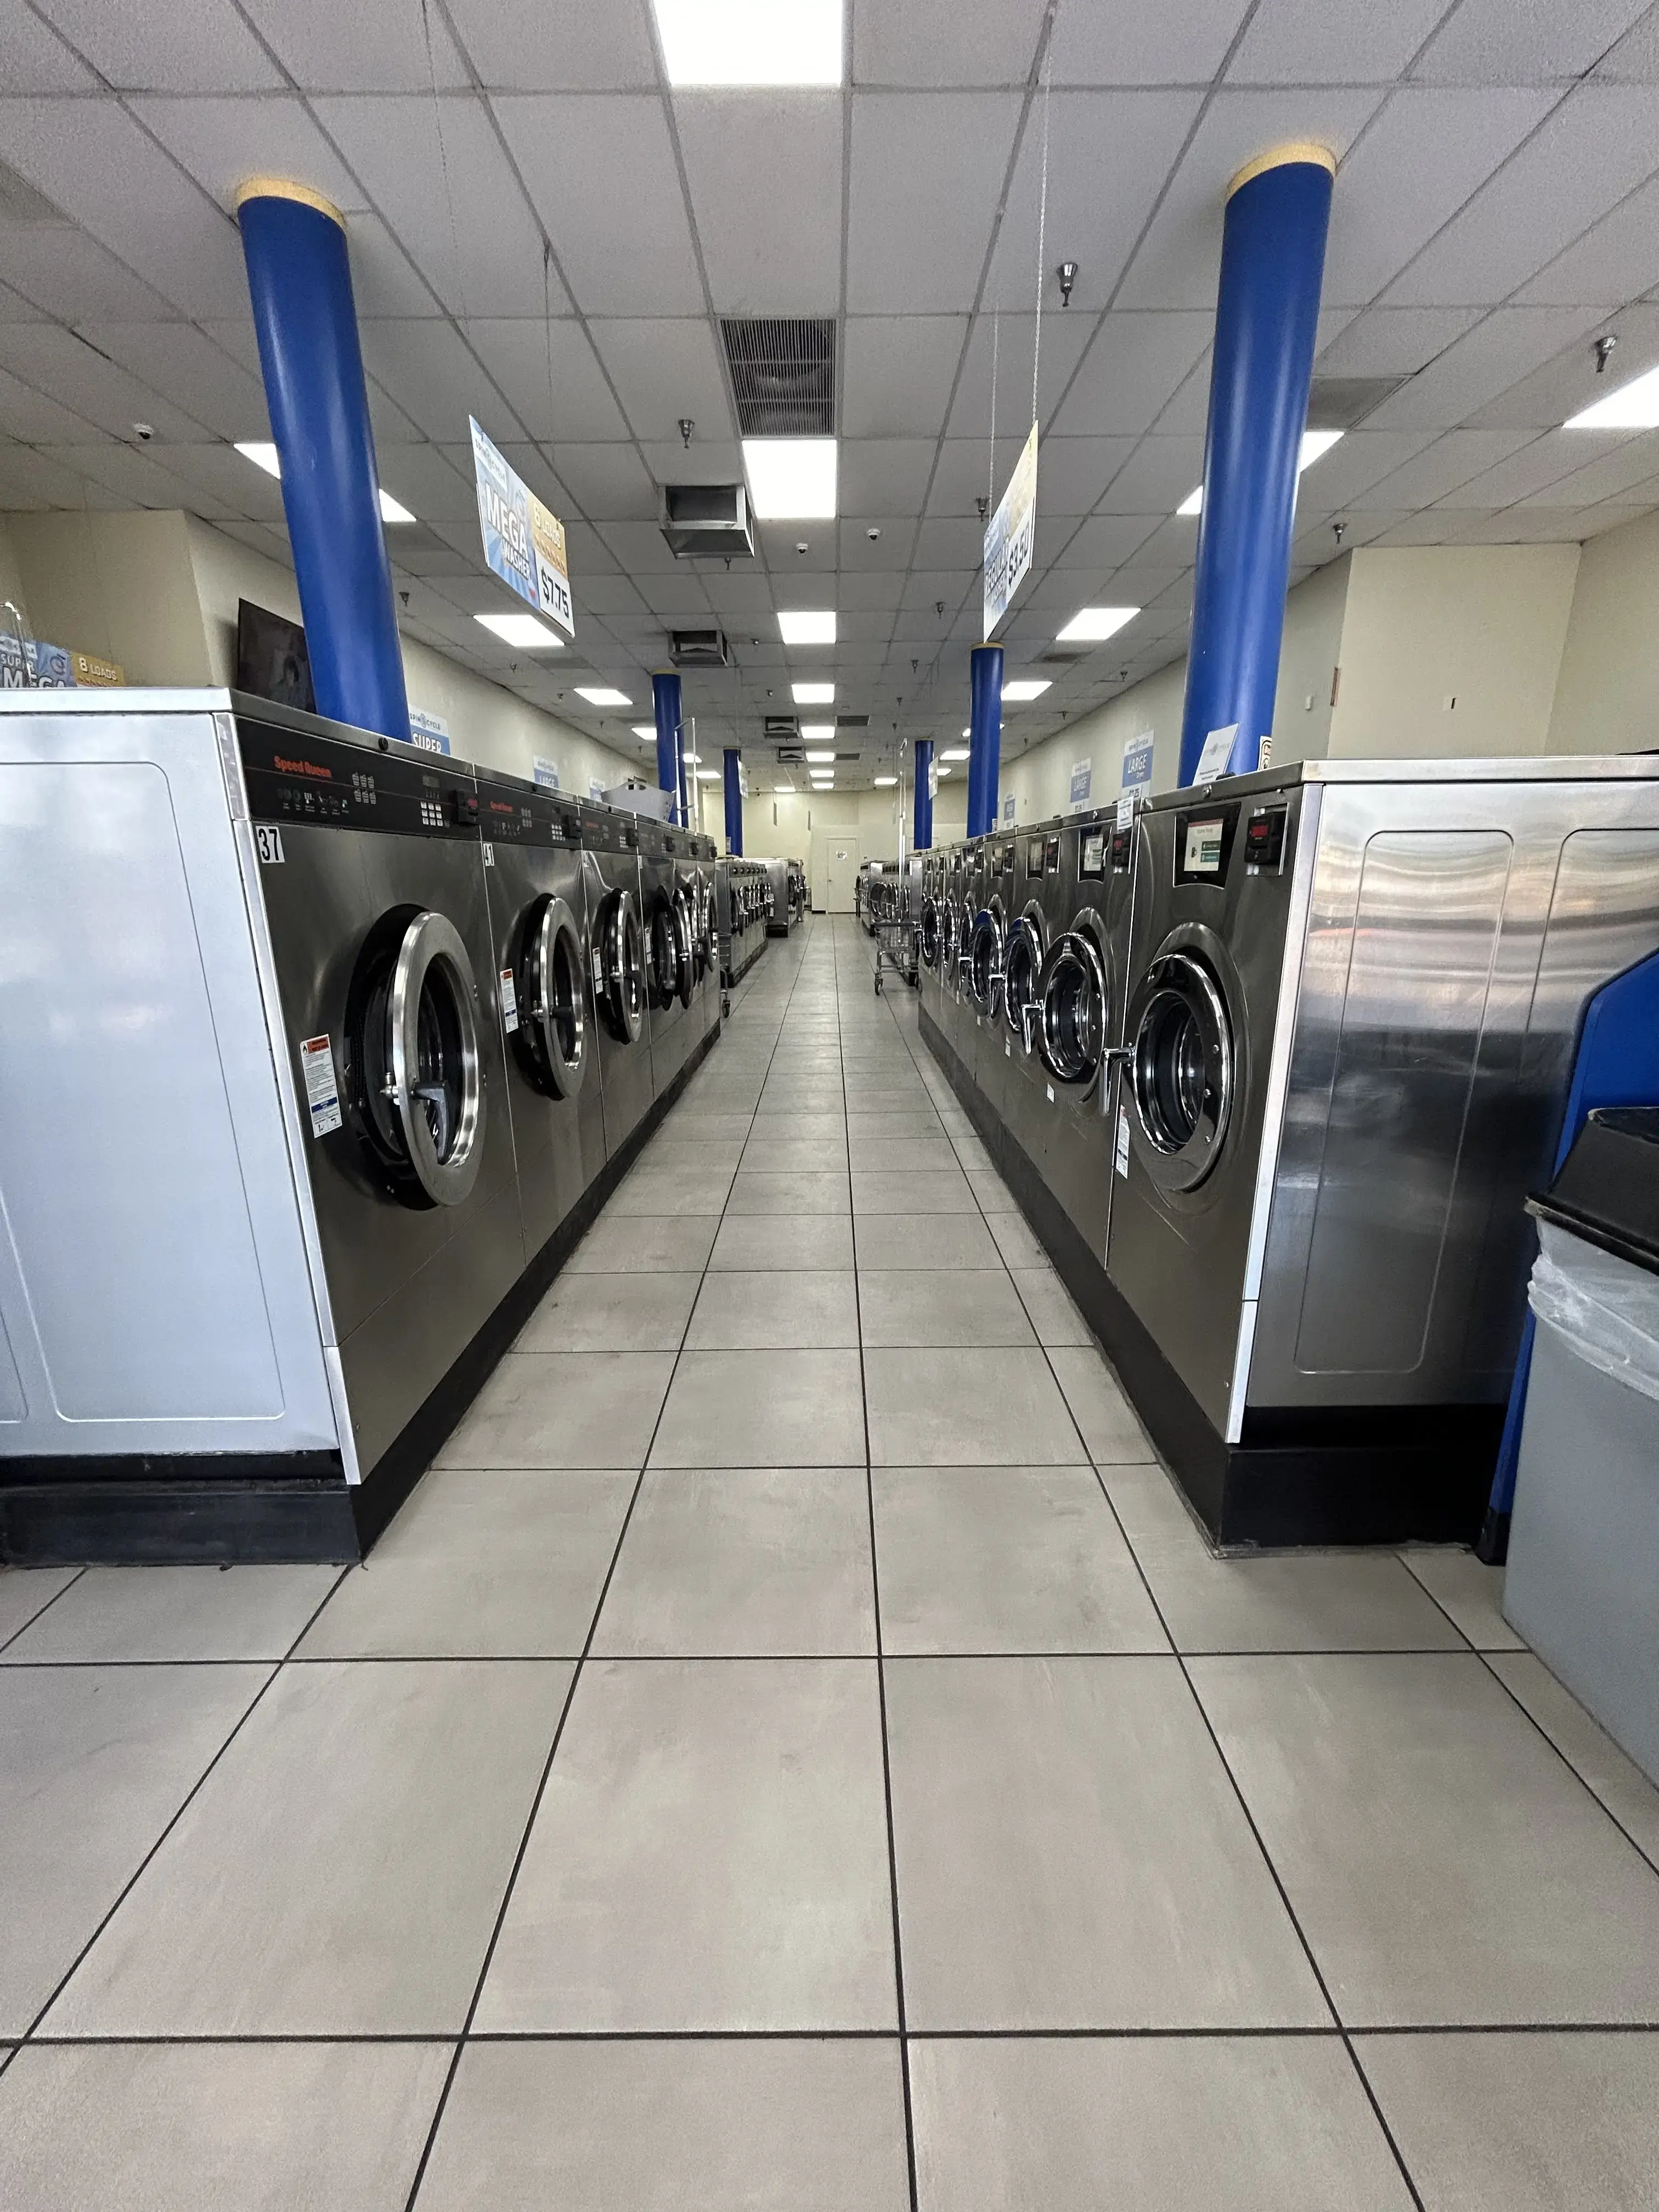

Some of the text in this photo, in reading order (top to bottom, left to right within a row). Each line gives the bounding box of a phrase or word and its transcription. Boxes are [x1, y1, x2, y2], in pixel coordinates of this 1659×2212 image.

[486, 481, 529, 562] MEGA
[503, 536, 531, 580] WASHER
[1009, 520, 1029, 588] $3.50
[540, 566, 569, 619] $7.75
[0, 653, 35, 672] SUPR
[89, 665, 117, 681] LOADS
[426, 719, 441, 730] CYCLE
[413, 731, 442, 753] SUPER
[274, 755, 332, 778] Speed Queen
[1128, 753, 1148, 774] LARGE
[259, 828, 279, 861] 37
[485, 844, 493, 865] 41
